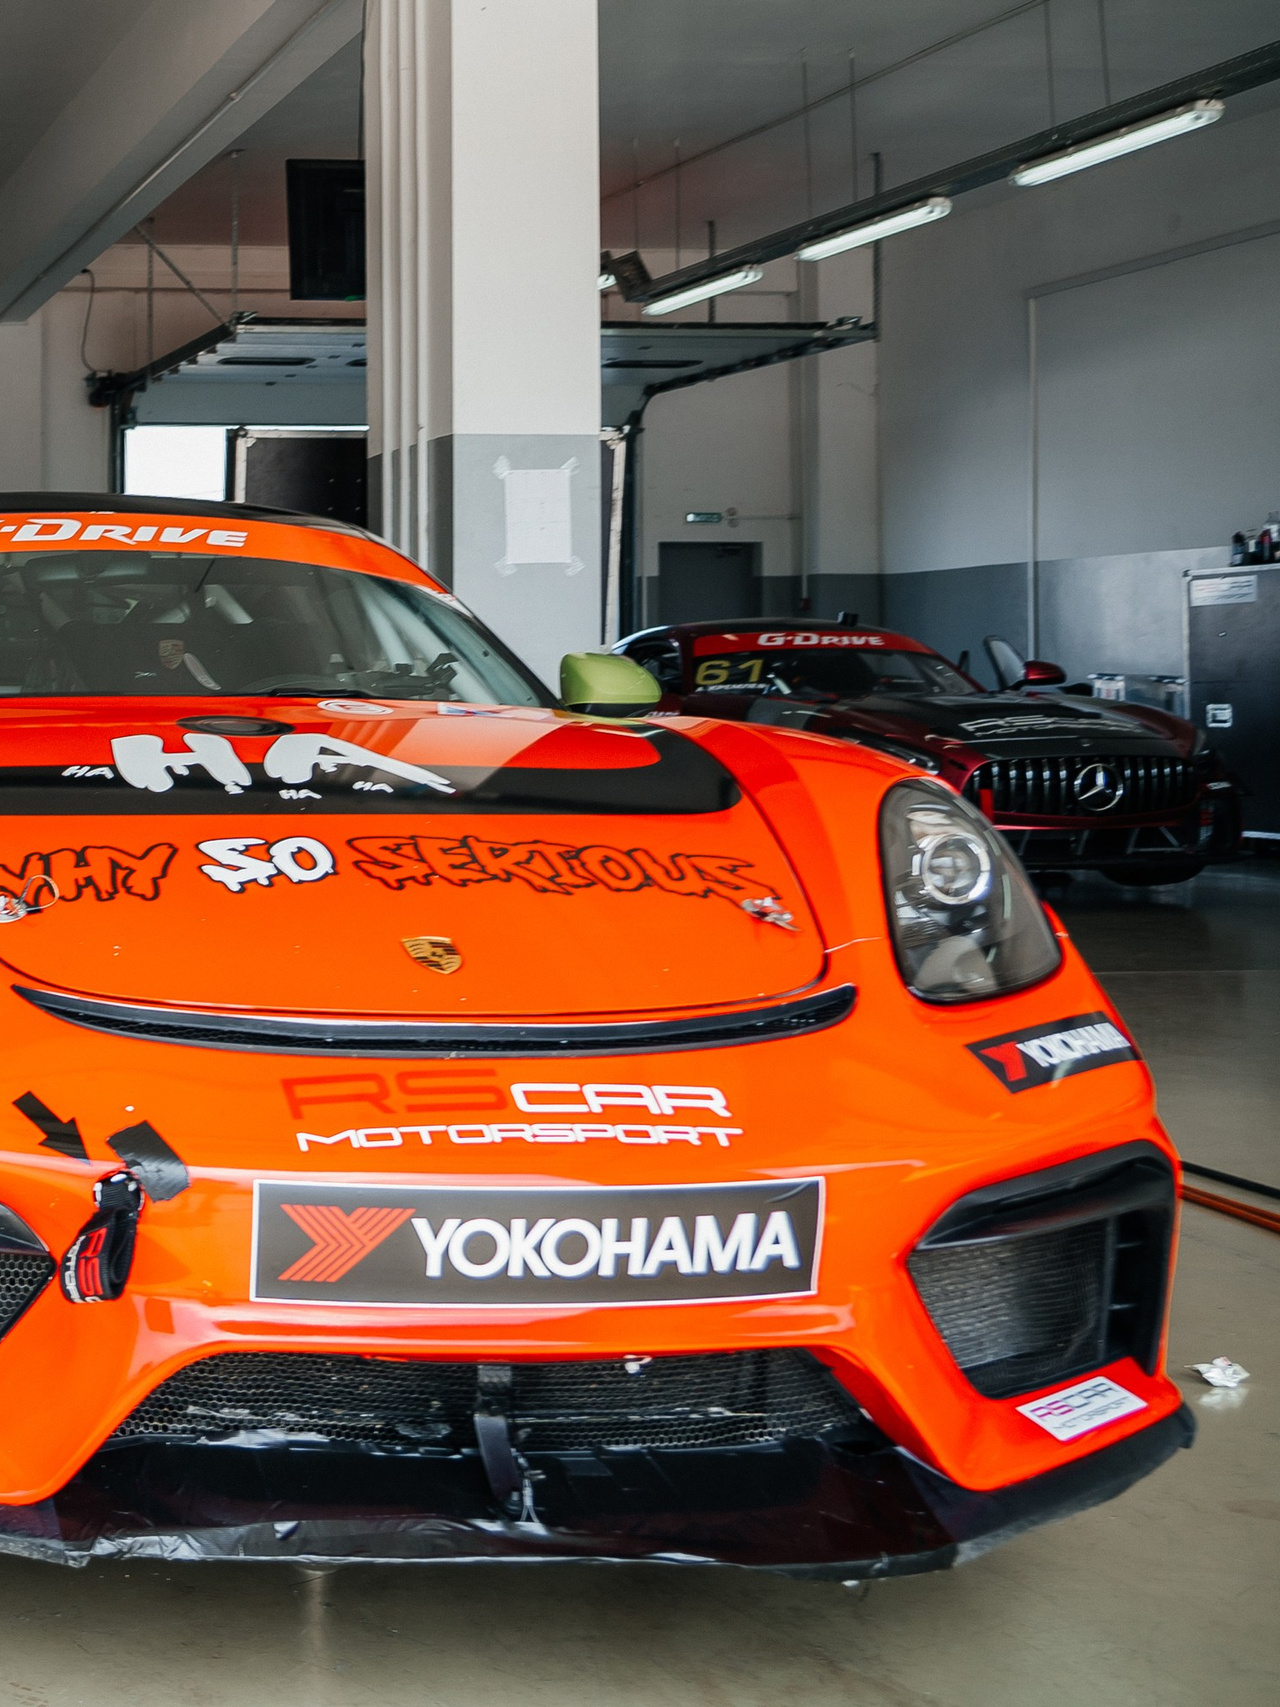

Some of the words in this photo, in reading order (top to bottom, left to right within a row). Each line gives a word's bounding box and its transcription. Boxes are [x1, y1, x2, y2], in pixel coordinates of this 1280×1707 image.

[695, 659, 764, 685] 61
[61, 764, 114, 779] HA
[111, 732, 457, 794] HA
[279, 788, 322, 799] HA
[195, 836, 340, 895] SO
[346, 835, 782, 905] SERIOUS
[297, 1123, 743, 1152] MOTORSPORT
[411, 1211, 802, 1278] YOKOHAMA
